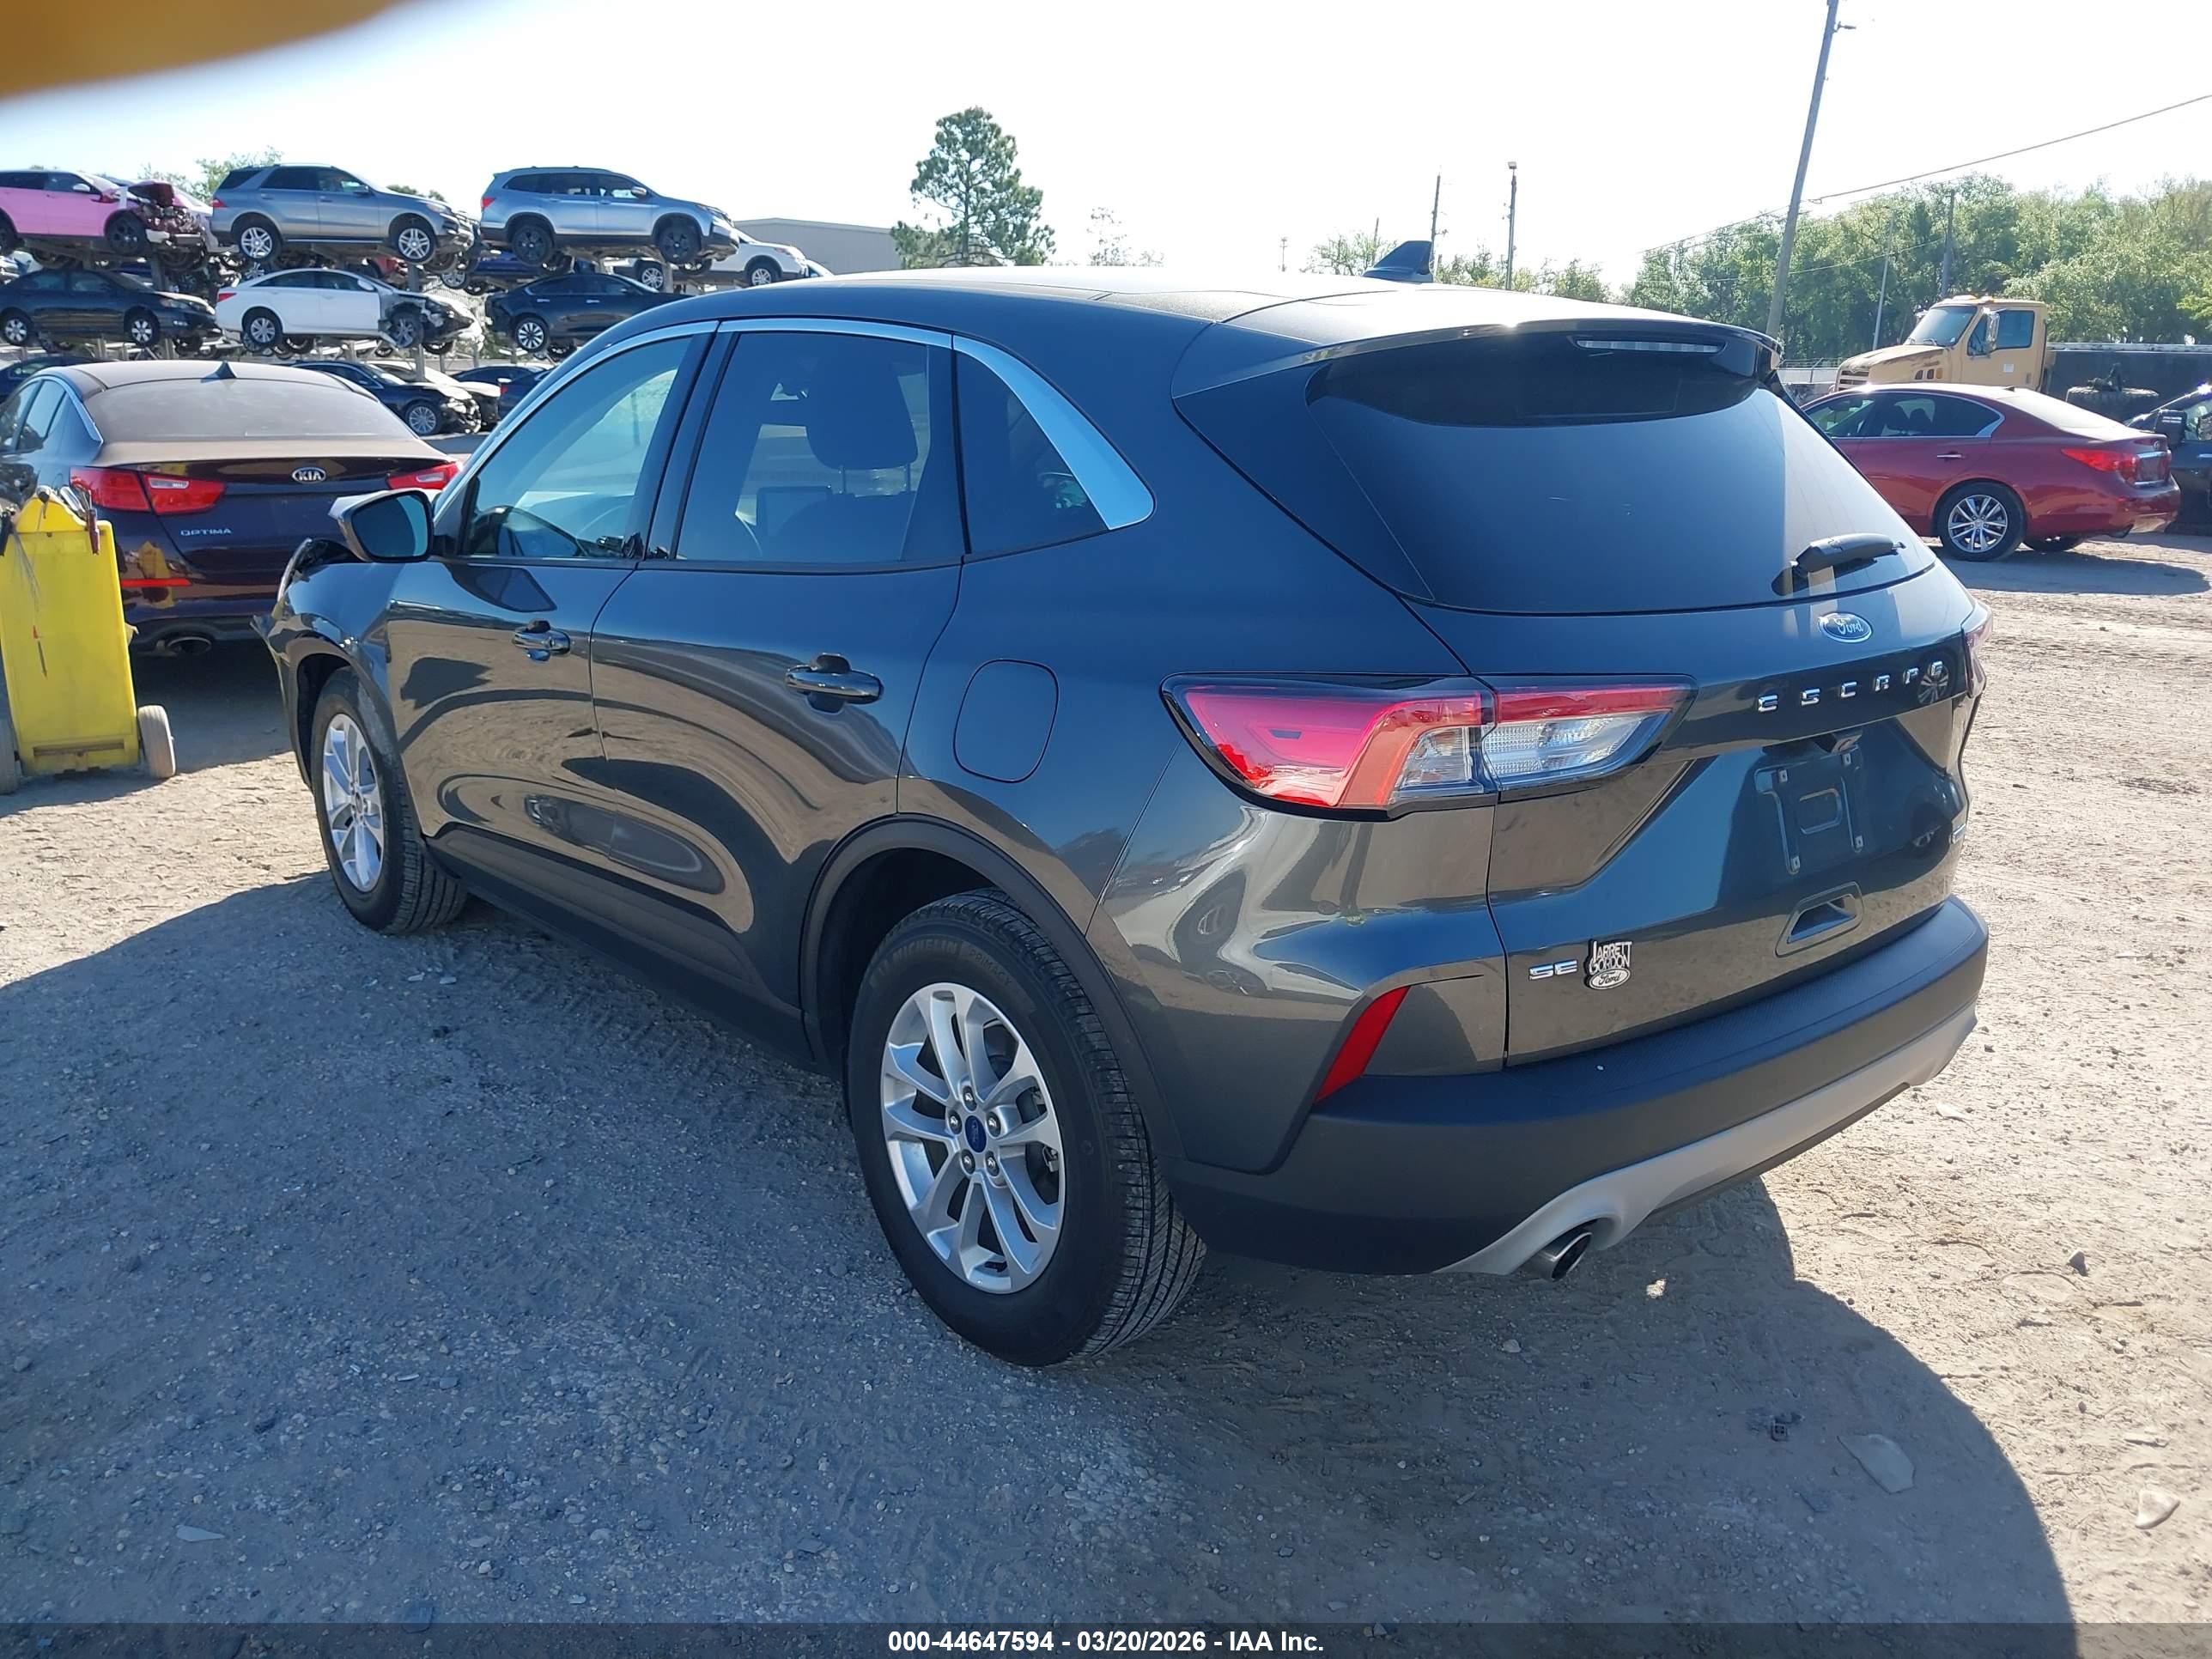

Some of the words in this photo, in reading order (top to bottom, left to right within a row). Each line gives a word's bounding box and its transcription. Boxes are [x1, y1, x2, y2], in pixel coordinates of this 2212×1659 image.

[299, 471, 322, 481] KIA
[1834, 616, 1864, 635] Ford
[1758, 660, 1943, 713] ESCAPE
[892, 939, 958, 961] MICHELIN
[1593, 941, 1632, 963] JARRETT
[1529, 960, 1577, 980] SE
[1589, 955, 1631, 975] GORDON
[1599, 972, 1621, 985] Ford
